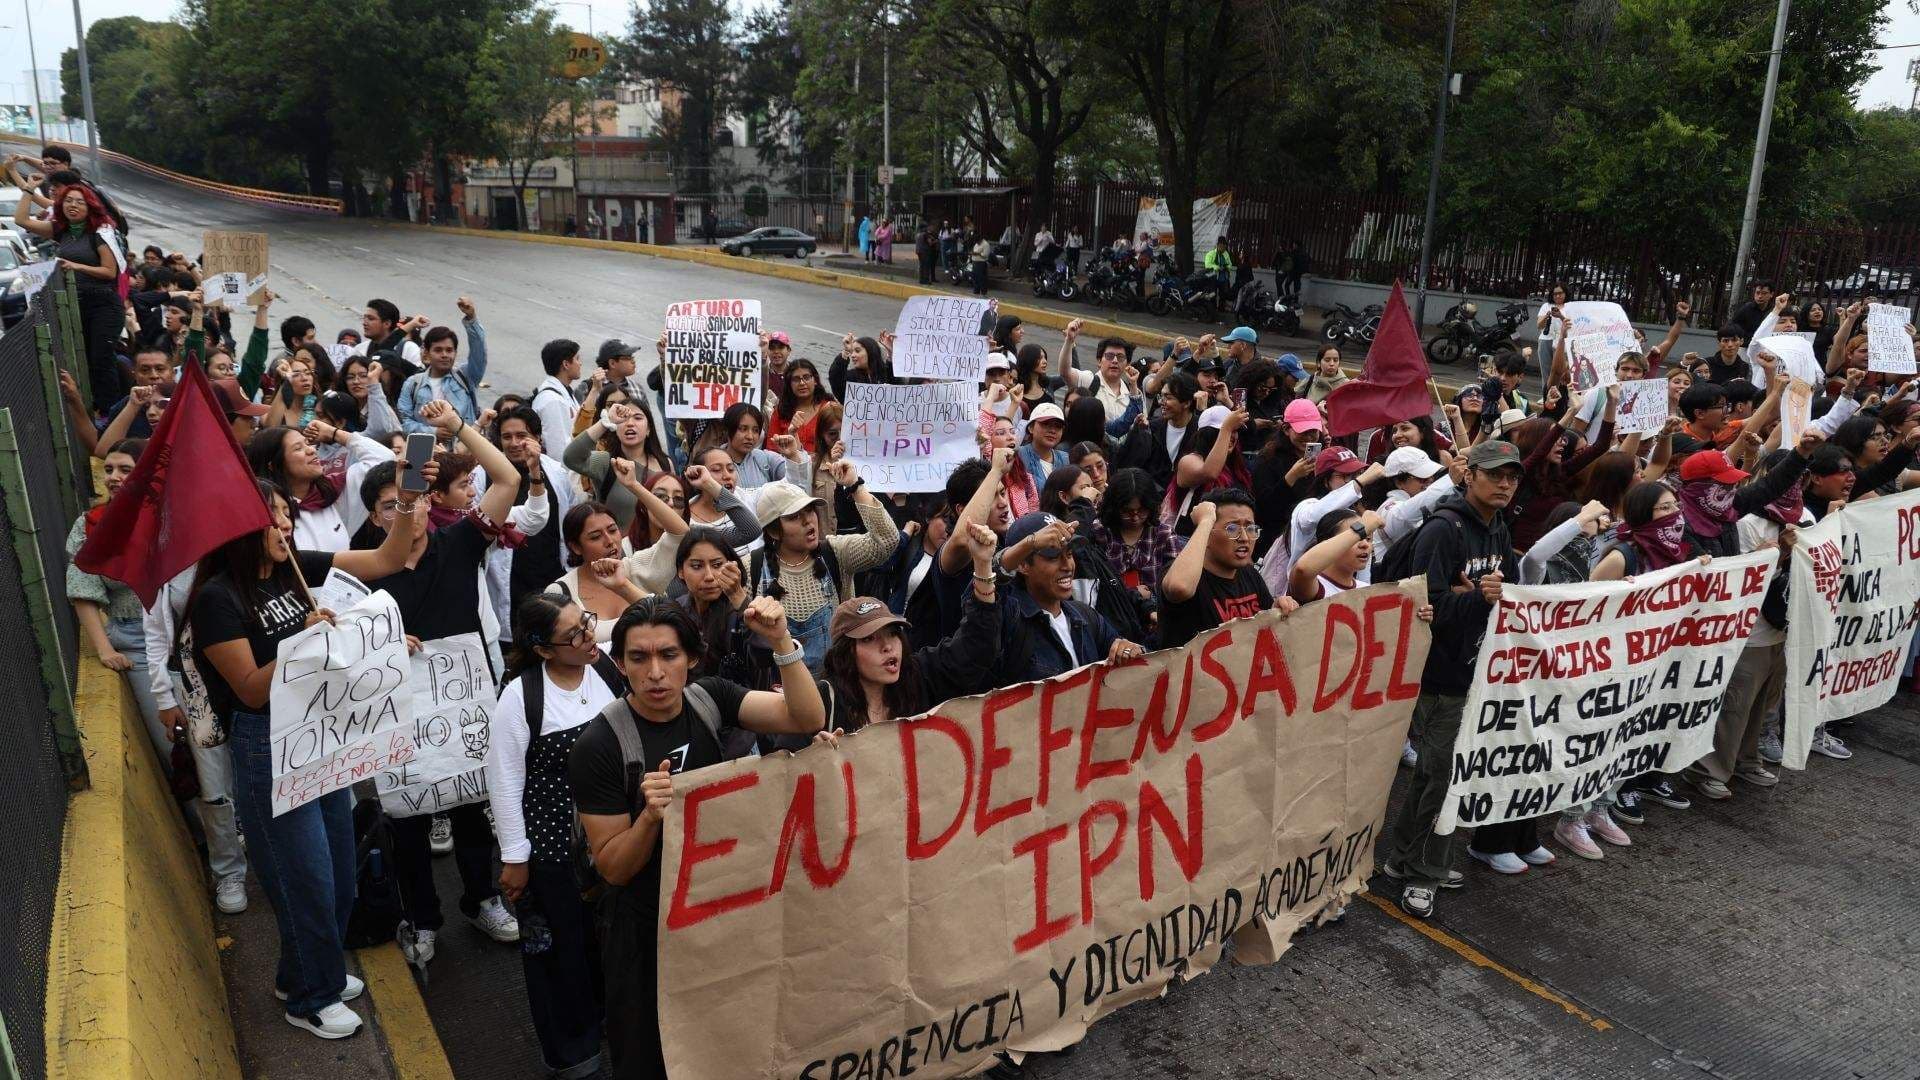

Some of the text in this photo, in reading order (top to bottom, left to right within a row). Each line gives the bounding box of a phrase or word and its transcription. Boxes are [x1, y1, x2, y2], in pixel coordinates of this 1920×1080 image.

[667, 300, 744, 317] ARTURO
[926, 297, 981, 319] MI BECA
[707, 316, 760, 336] SANDOVAL
[910, 316, 945, 331] SIGUE
[948, 317, 967, 333] EN
[667, 331, 728, 350] LLENASTE
[905, 333, 984, 356] TRANSCURSO
[667, 349, 695, 364] TUS
[904, 353, 980, 379] DE LA SEMANA
[667, 363, 753, 387] VACIASTE
[668, 384, 689, 405] AL
[847, 382, 976, 403] NOS QUITARON TANTO
[845, 401, 874, 421] QUE
[877, 402, 905, 423] NOS
[906, 402, 965, 423] QUITARON
[850, 422, 957, 437] MIEDO
[851, 437, 931, 457] EL IPN
[879, 465, 897, 484] SE
[1838, 568, 1881, 603] NICA
[1213, 593, 1261, 623] VANS
[1495, 564, 1769, 635] ESCUELA NACIONAL DE
[1864, 610, 1886, 645] DE
[283, 632, 351, 683] EL
[356, 606, 402, 659] POLI
[1486, 637, 1612, 685] CIENCIAS
[1831, 647, 1902, 696] OBRERA
[303, 654, 402, 722] NOS
[1477, 699, 1524, 734] DE
[1530, 694, 1562, 727] LA
[1661, 660, 1681, 690] A
[1693, 656, 1723, 689] LA
[667, 592, 1423, 931] EN DEFENSA DEL
[1453, 736, 1552, 785] NACIÓN
[1565, 728, 1613, 768] SIN
[1458, 793, 1493, 822] NO
[1504, 783, 1565, 819] HAY
[1013, 753, 1203, 953] IPN
[1050, 956, 1077, 1018] Y
[1084, 888, 1243, 1006] DIGNIDAD
